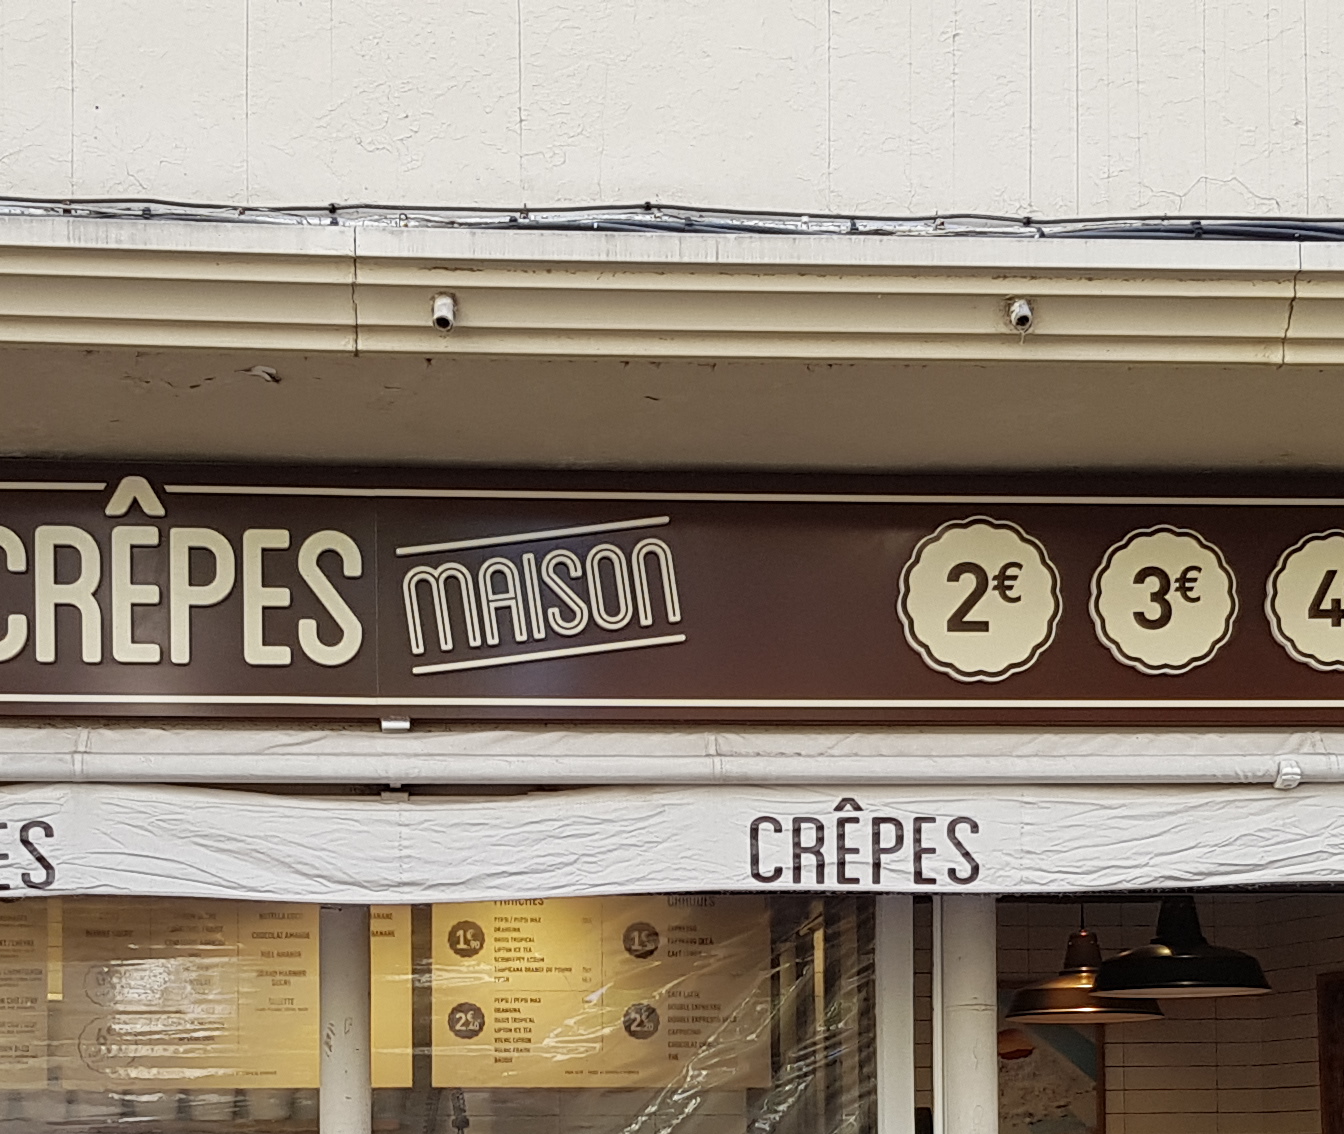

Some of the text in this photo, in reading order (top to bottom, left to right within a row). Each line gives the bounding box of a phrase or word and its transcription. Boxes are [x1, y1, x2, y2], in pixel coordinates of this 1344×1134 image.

[402, 537, 682, 655] MAISON
[946, 561, 1024, 633] 2€
[1132, 565, 1203, 631] 3€
[750, 798, 980, 885] CRÊPES
